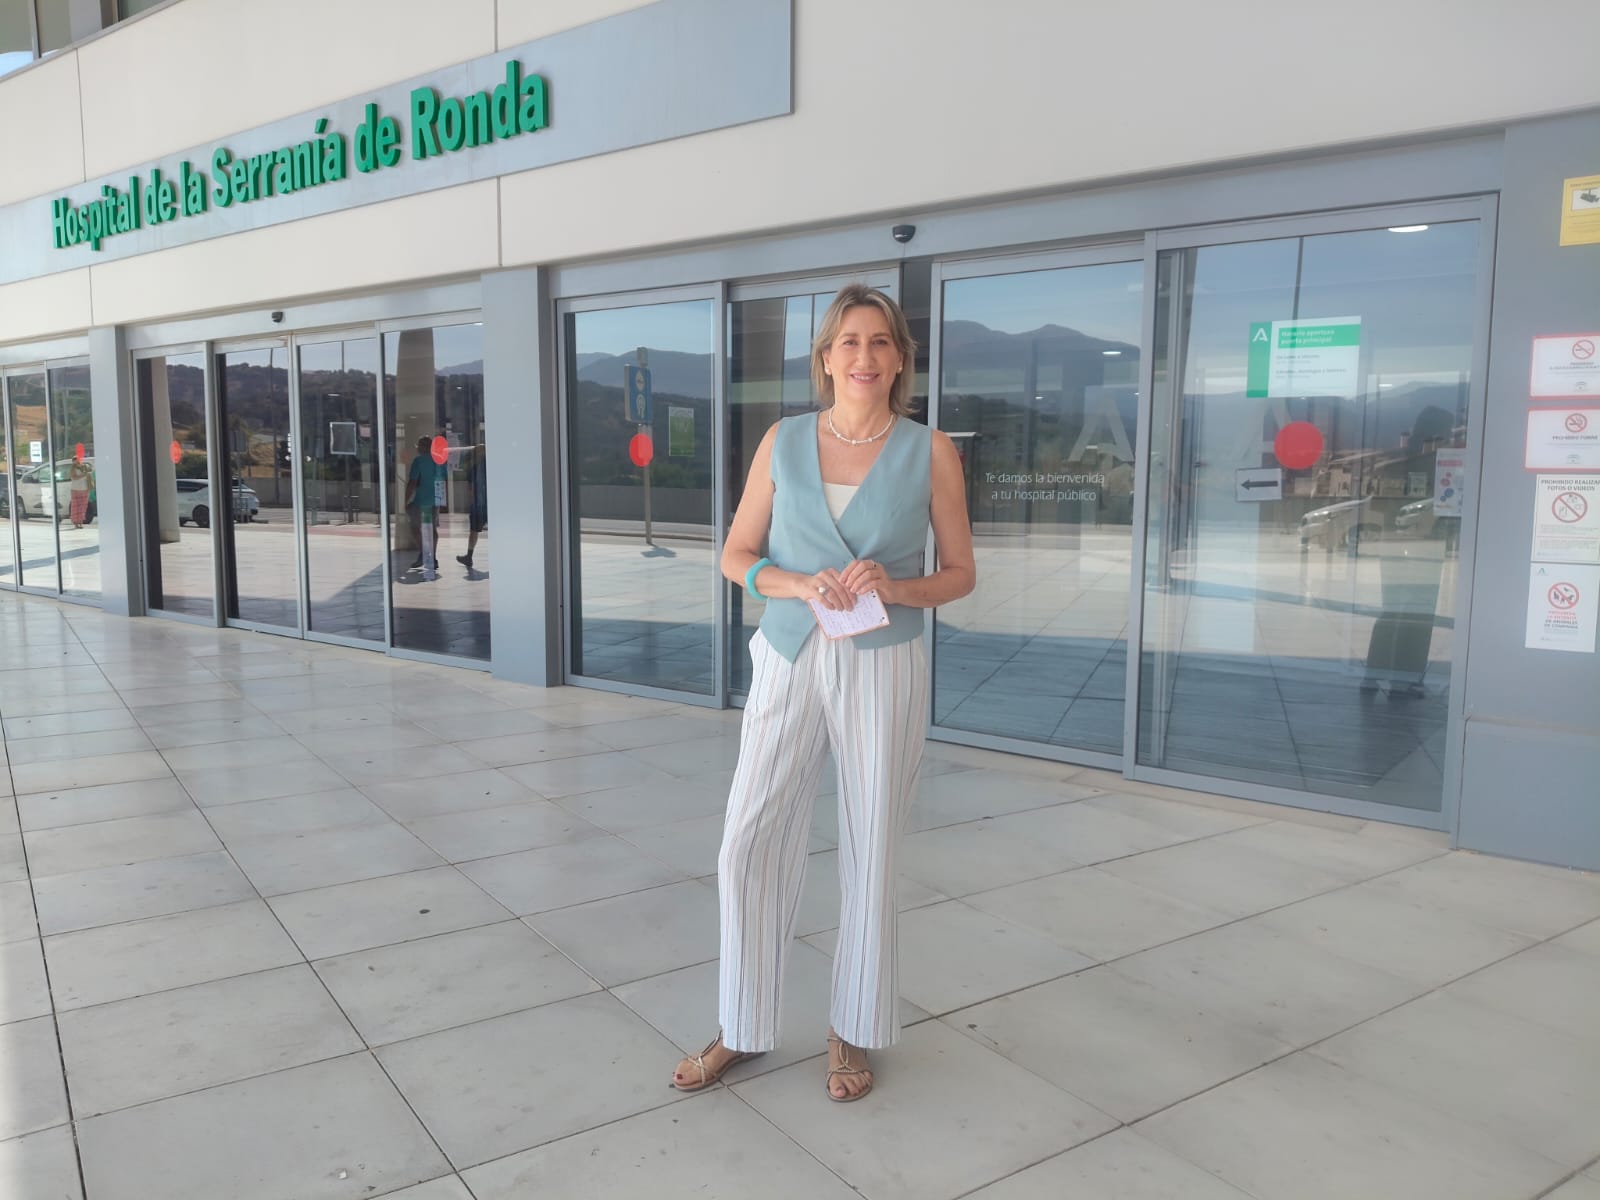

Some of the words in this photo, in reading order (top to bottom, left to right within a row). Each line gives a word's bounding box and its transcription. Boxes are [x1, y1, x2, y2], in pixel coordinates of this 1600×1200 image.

[53, 176, 141, 251] Hospital
[144, 170, 177, 225] de
[181, 162, 207, 218] la
[213, 119, 347, 208] Serranía
[354, 104, 401, 173] de
[411, 61, 549, 161] Ronda
[985, 472, 996, 483] Te
[998, 472, 1033, 483] damos
[1035, 472, 1044, 483] la
[1047, 472, 1105, 484] bienvenida
[991, 490, 998, 500] a
[1000, 490, 1012, 500] tu
[1014, 489, 1055, 502] hospital
[1057, 488, 1097, 503] público
